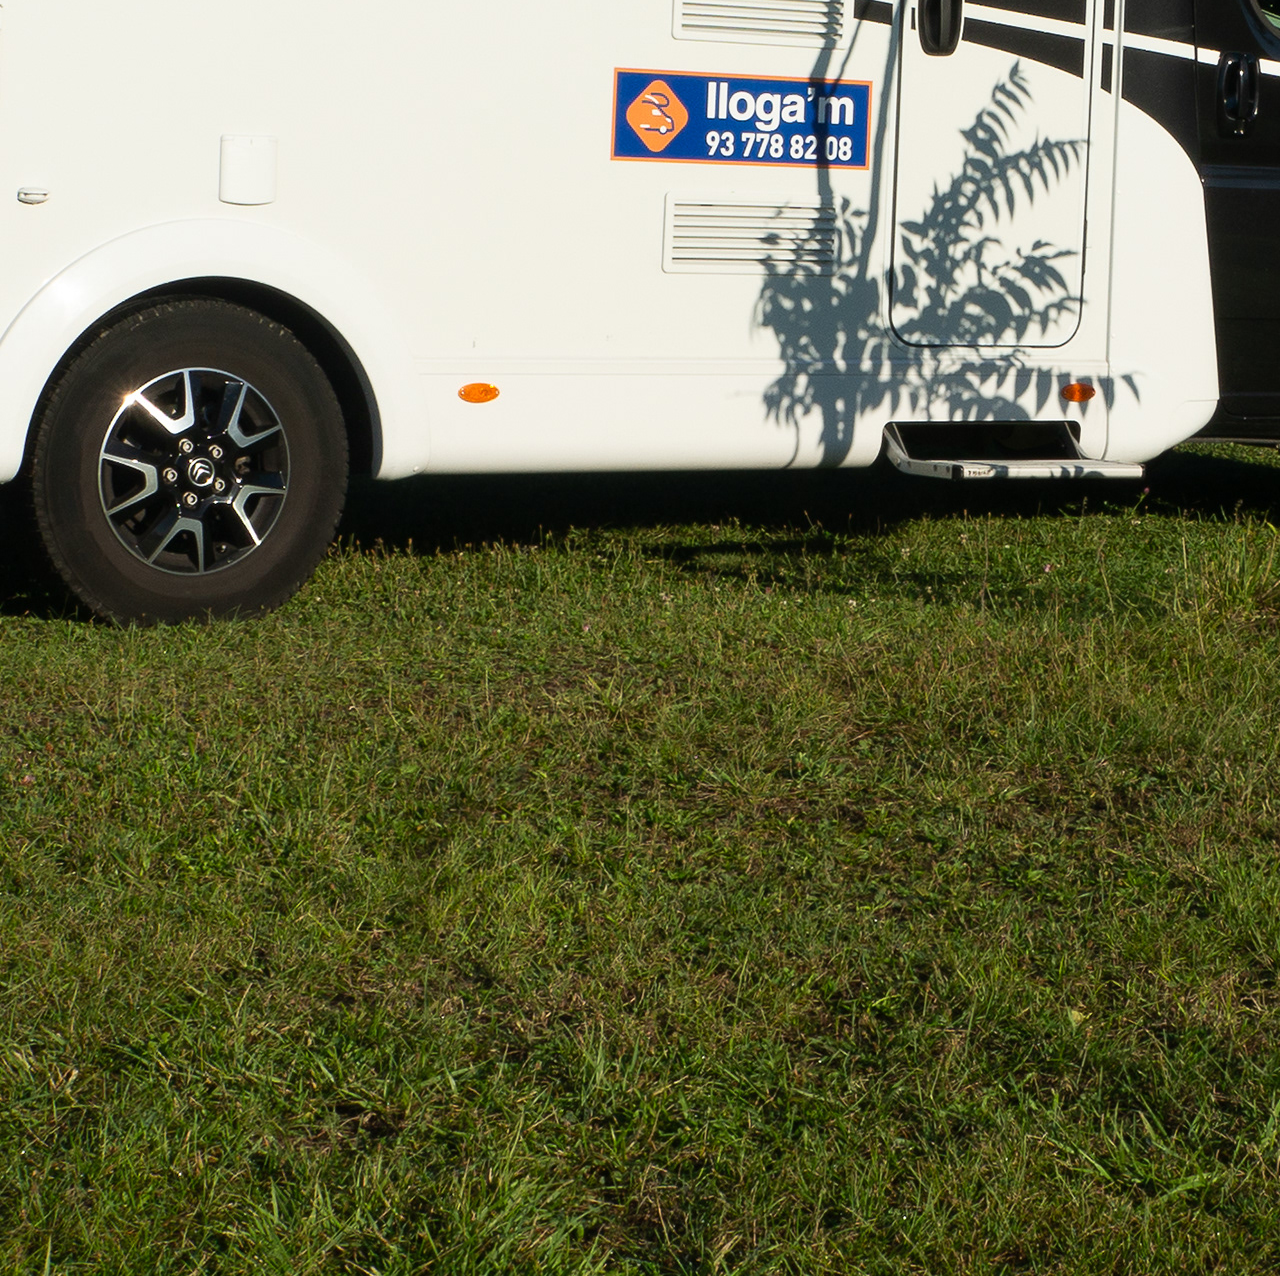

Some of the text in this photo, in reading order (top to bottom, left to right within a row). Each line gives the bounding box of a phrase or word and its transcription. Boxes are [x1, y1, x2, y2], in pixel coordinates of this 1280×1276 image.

[706, 81, 854, 132] lloga'm
[706, 130, 853, 162] 93 778 82 08
